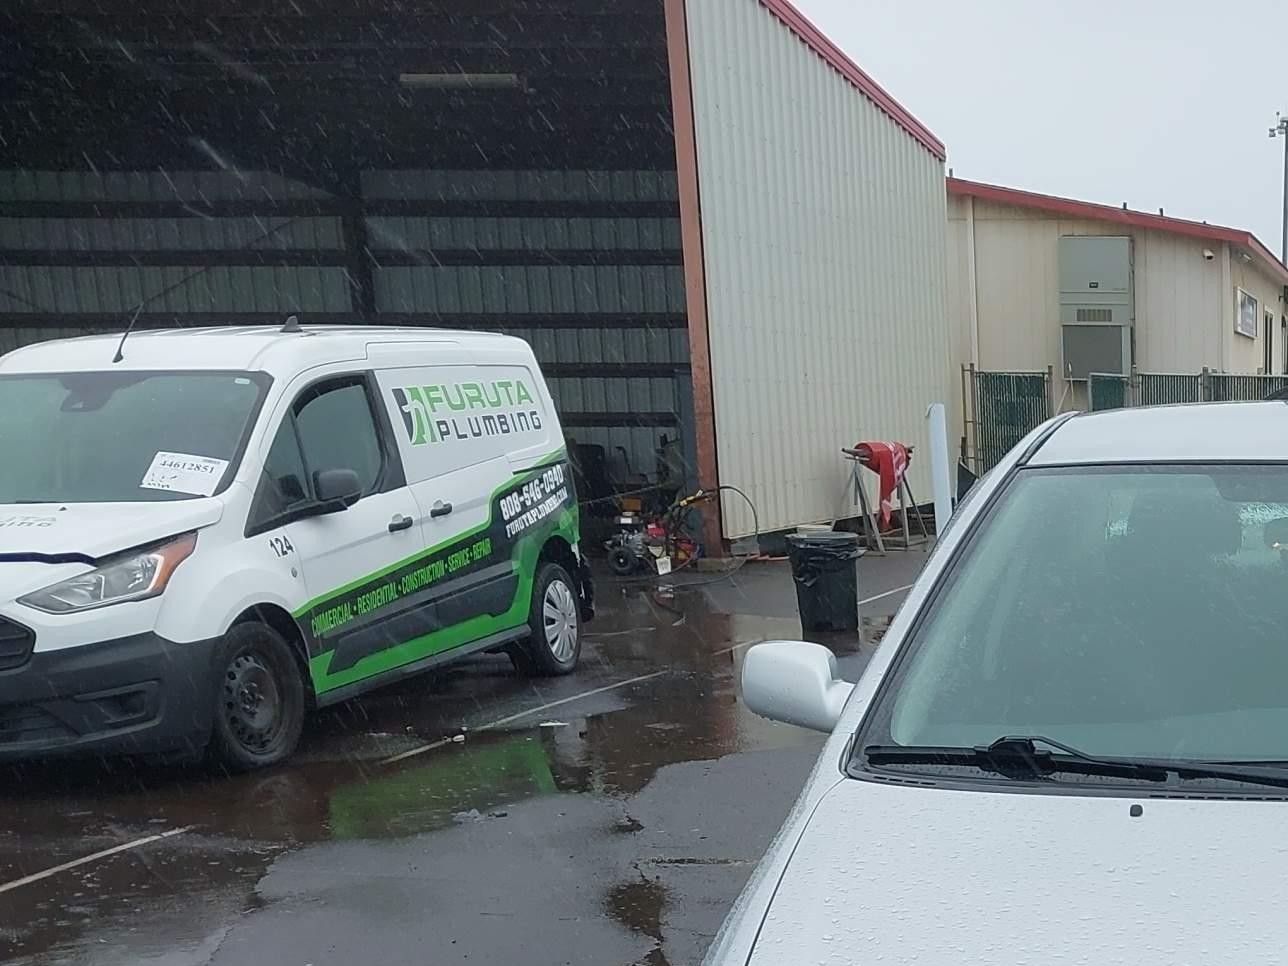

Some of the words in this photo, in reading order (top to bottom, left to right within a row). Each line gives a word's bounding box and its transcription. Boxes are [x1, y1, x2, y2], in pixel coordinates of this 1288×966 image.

[423, 380, 534, 412] FURUTA
[436, 410, 541, 441] PLUMBING
[160, 460, 215, 474] 44612851
[500, 464, 564, 521] 808-546-0940
[269, 535, 294, 557] 124
[311, 601, 354, 638] COMMERCIAL
[357, 581, 399, 616] RESIDENTIAL
[401, 559, 446, 595] CONSTRUCTION
[447, 547, 471, 572] SERVICE
[473, 537, 492, 561] REPAIR
